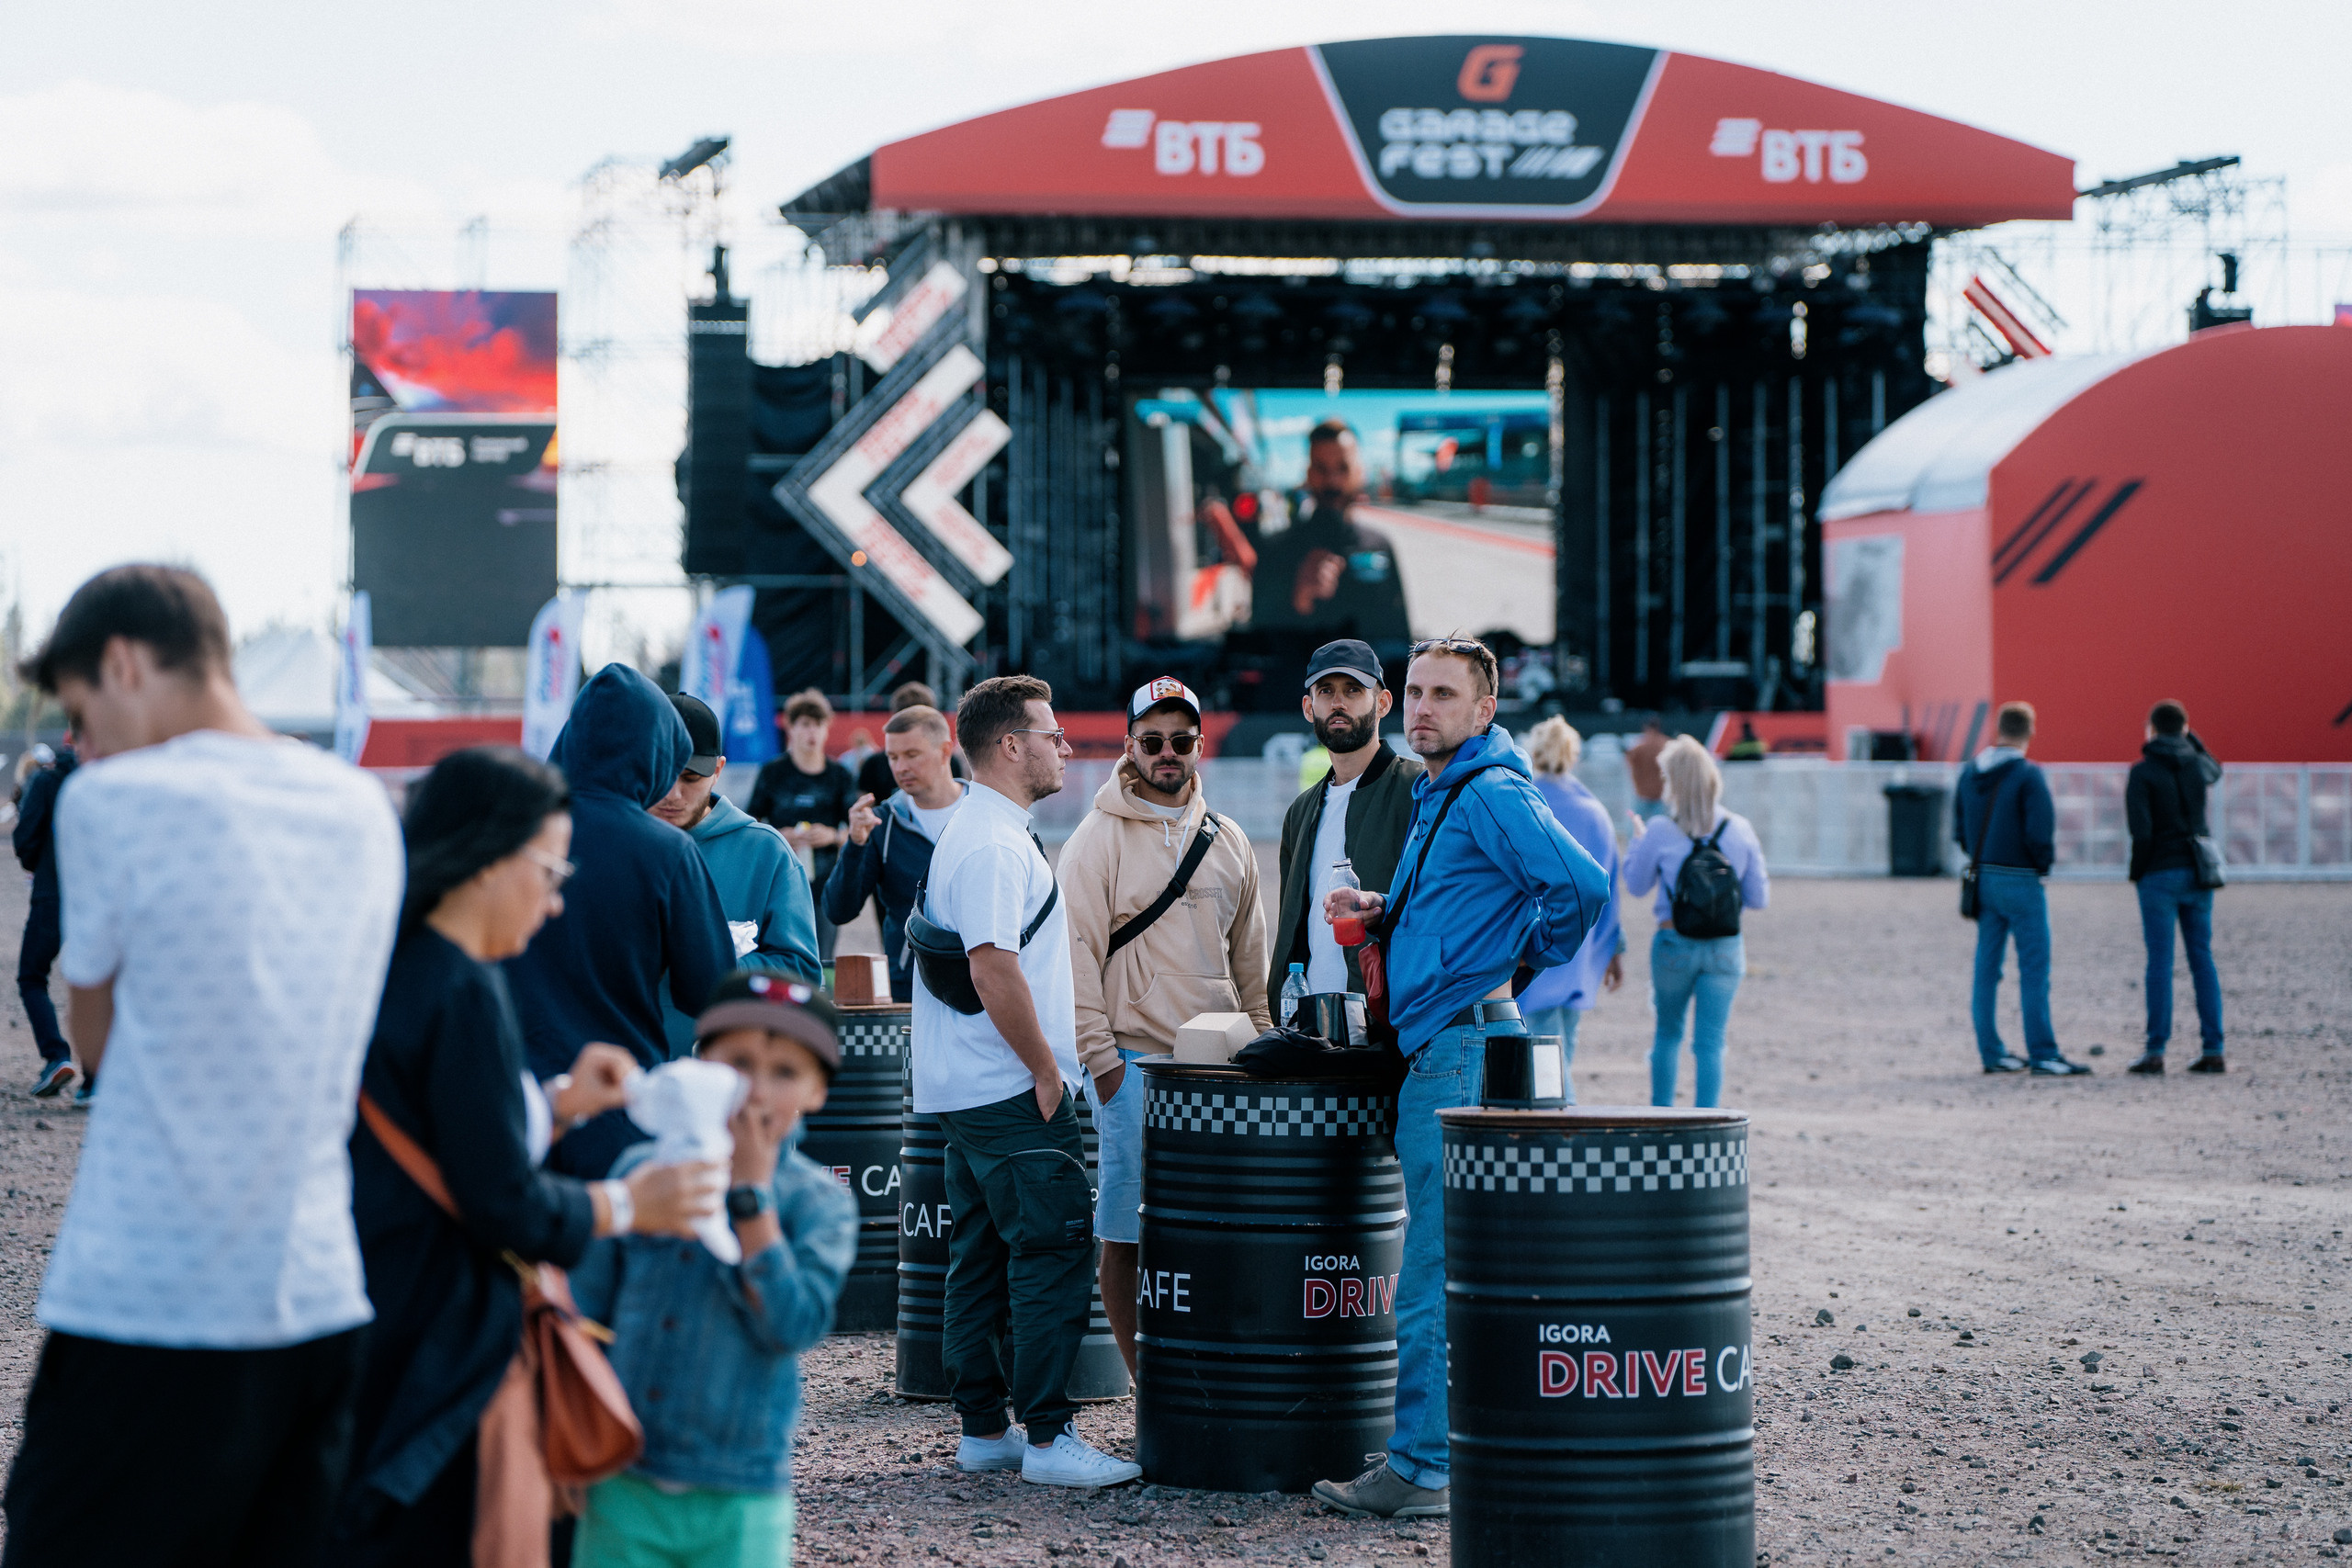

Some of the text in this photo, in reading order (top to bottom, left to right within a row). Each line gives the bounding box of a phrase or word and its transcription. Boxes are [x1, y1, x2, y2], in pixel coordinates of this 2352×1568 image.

[1155, 121, 1265, 176] ВТБ
[1761, 130, 1869, 183] ВТБ
[1305, 1255, 1361, 1271] IGORA
[1136, 1266, 1191, 1313] AFE
[1304, 1273, 1399, 1318] DRIV
[1539, 1324, 1611, 1344] IGORA
[1539, 1348, 1707, 1398] DRIVE
